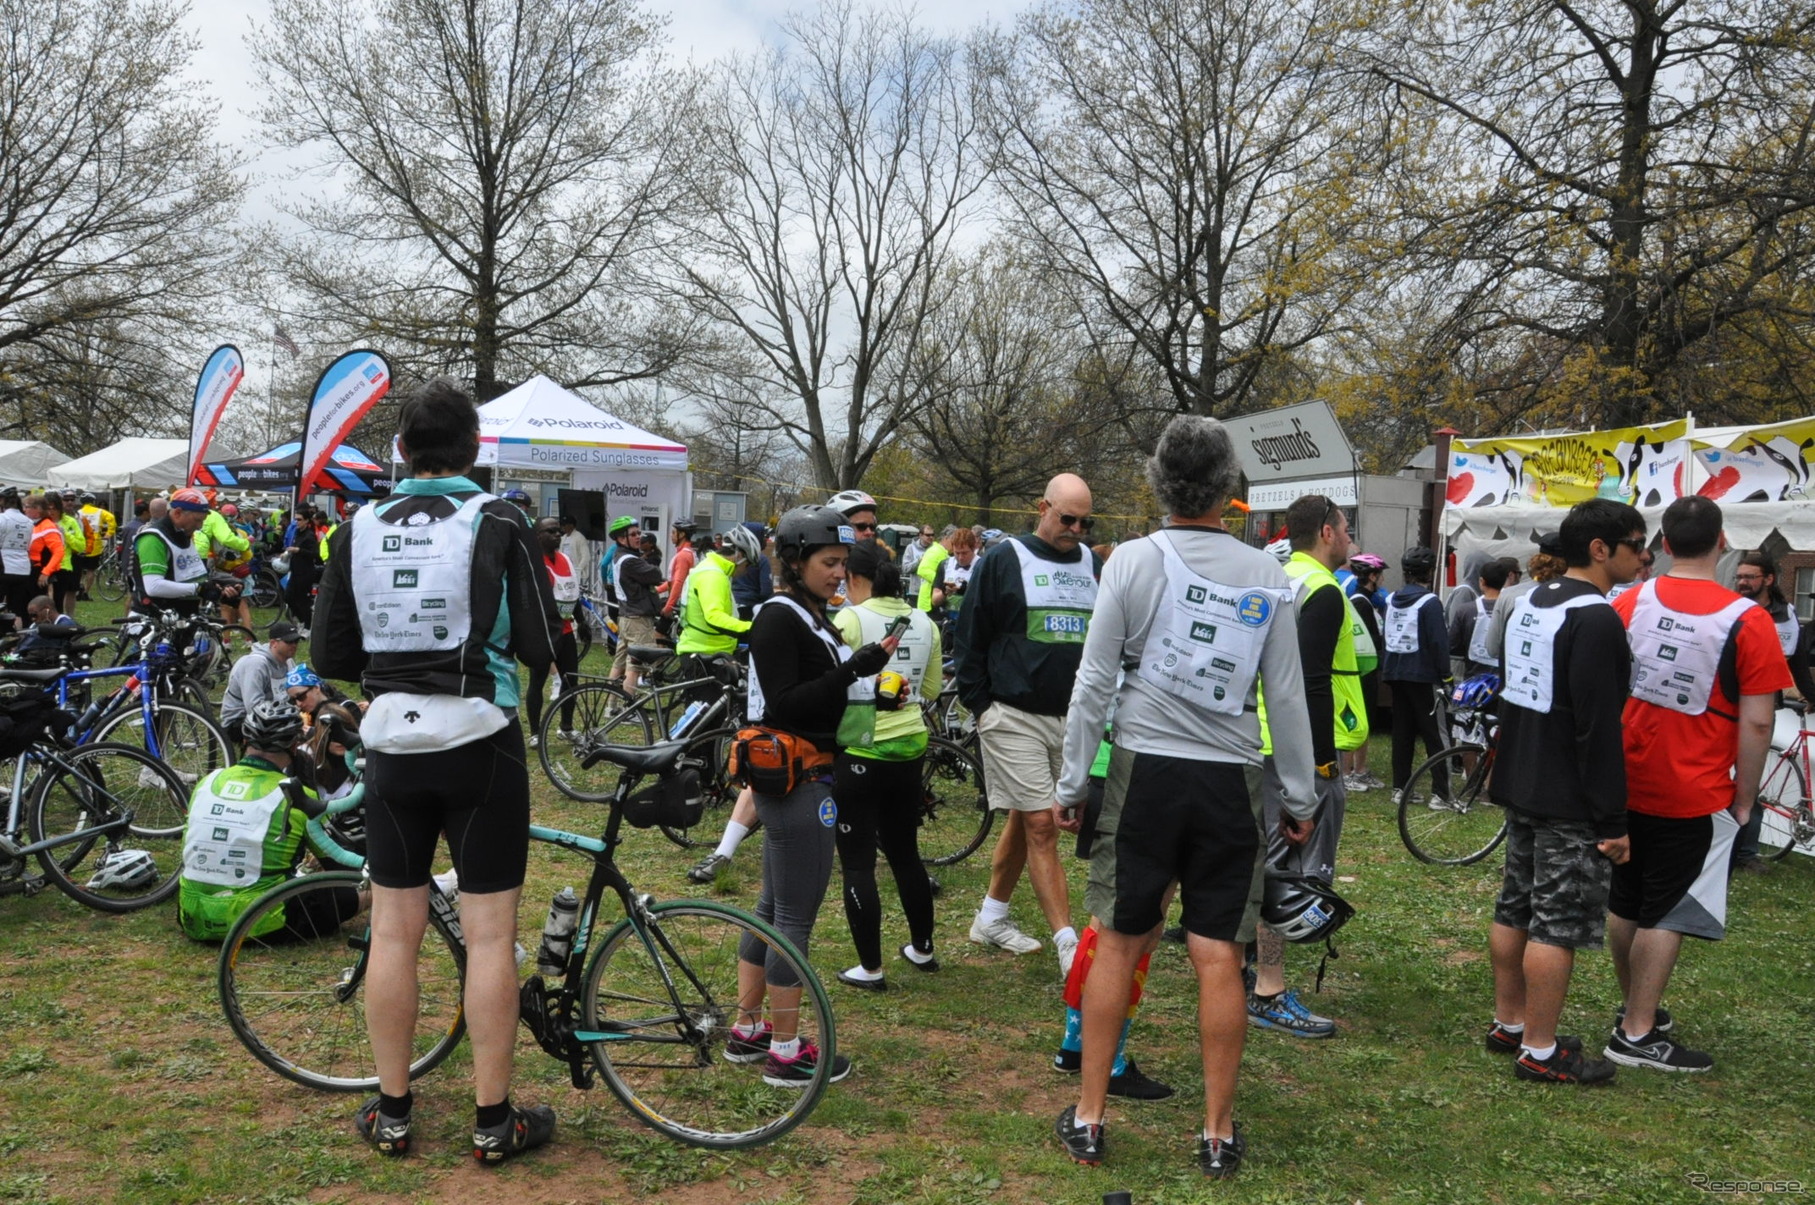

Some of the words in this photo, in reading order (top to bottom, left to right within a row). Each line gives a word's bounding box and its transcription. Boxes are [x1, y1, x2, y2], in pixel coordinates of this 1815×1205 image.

[311, 380, 367, 440] peopleforbikes.org
[544, 417, 625, 431] Polaroid
[530, 447, 588, 464] Polarized
[592, 450, 660, 467] Sunglasses
[610, 483, 648, 498] Polaroid
[1250, 489, 1295, 503] PRETZELS
[405, 537, 433, 546] Bank
[422, 600, 445, 608] Bicycling
[1209, 593, 1237, 608] Bank
[1050, 616, 1081, 632] 8313
[1674, 622, 1696, 633] Bank
[225, 807, 245, 815] Bank
